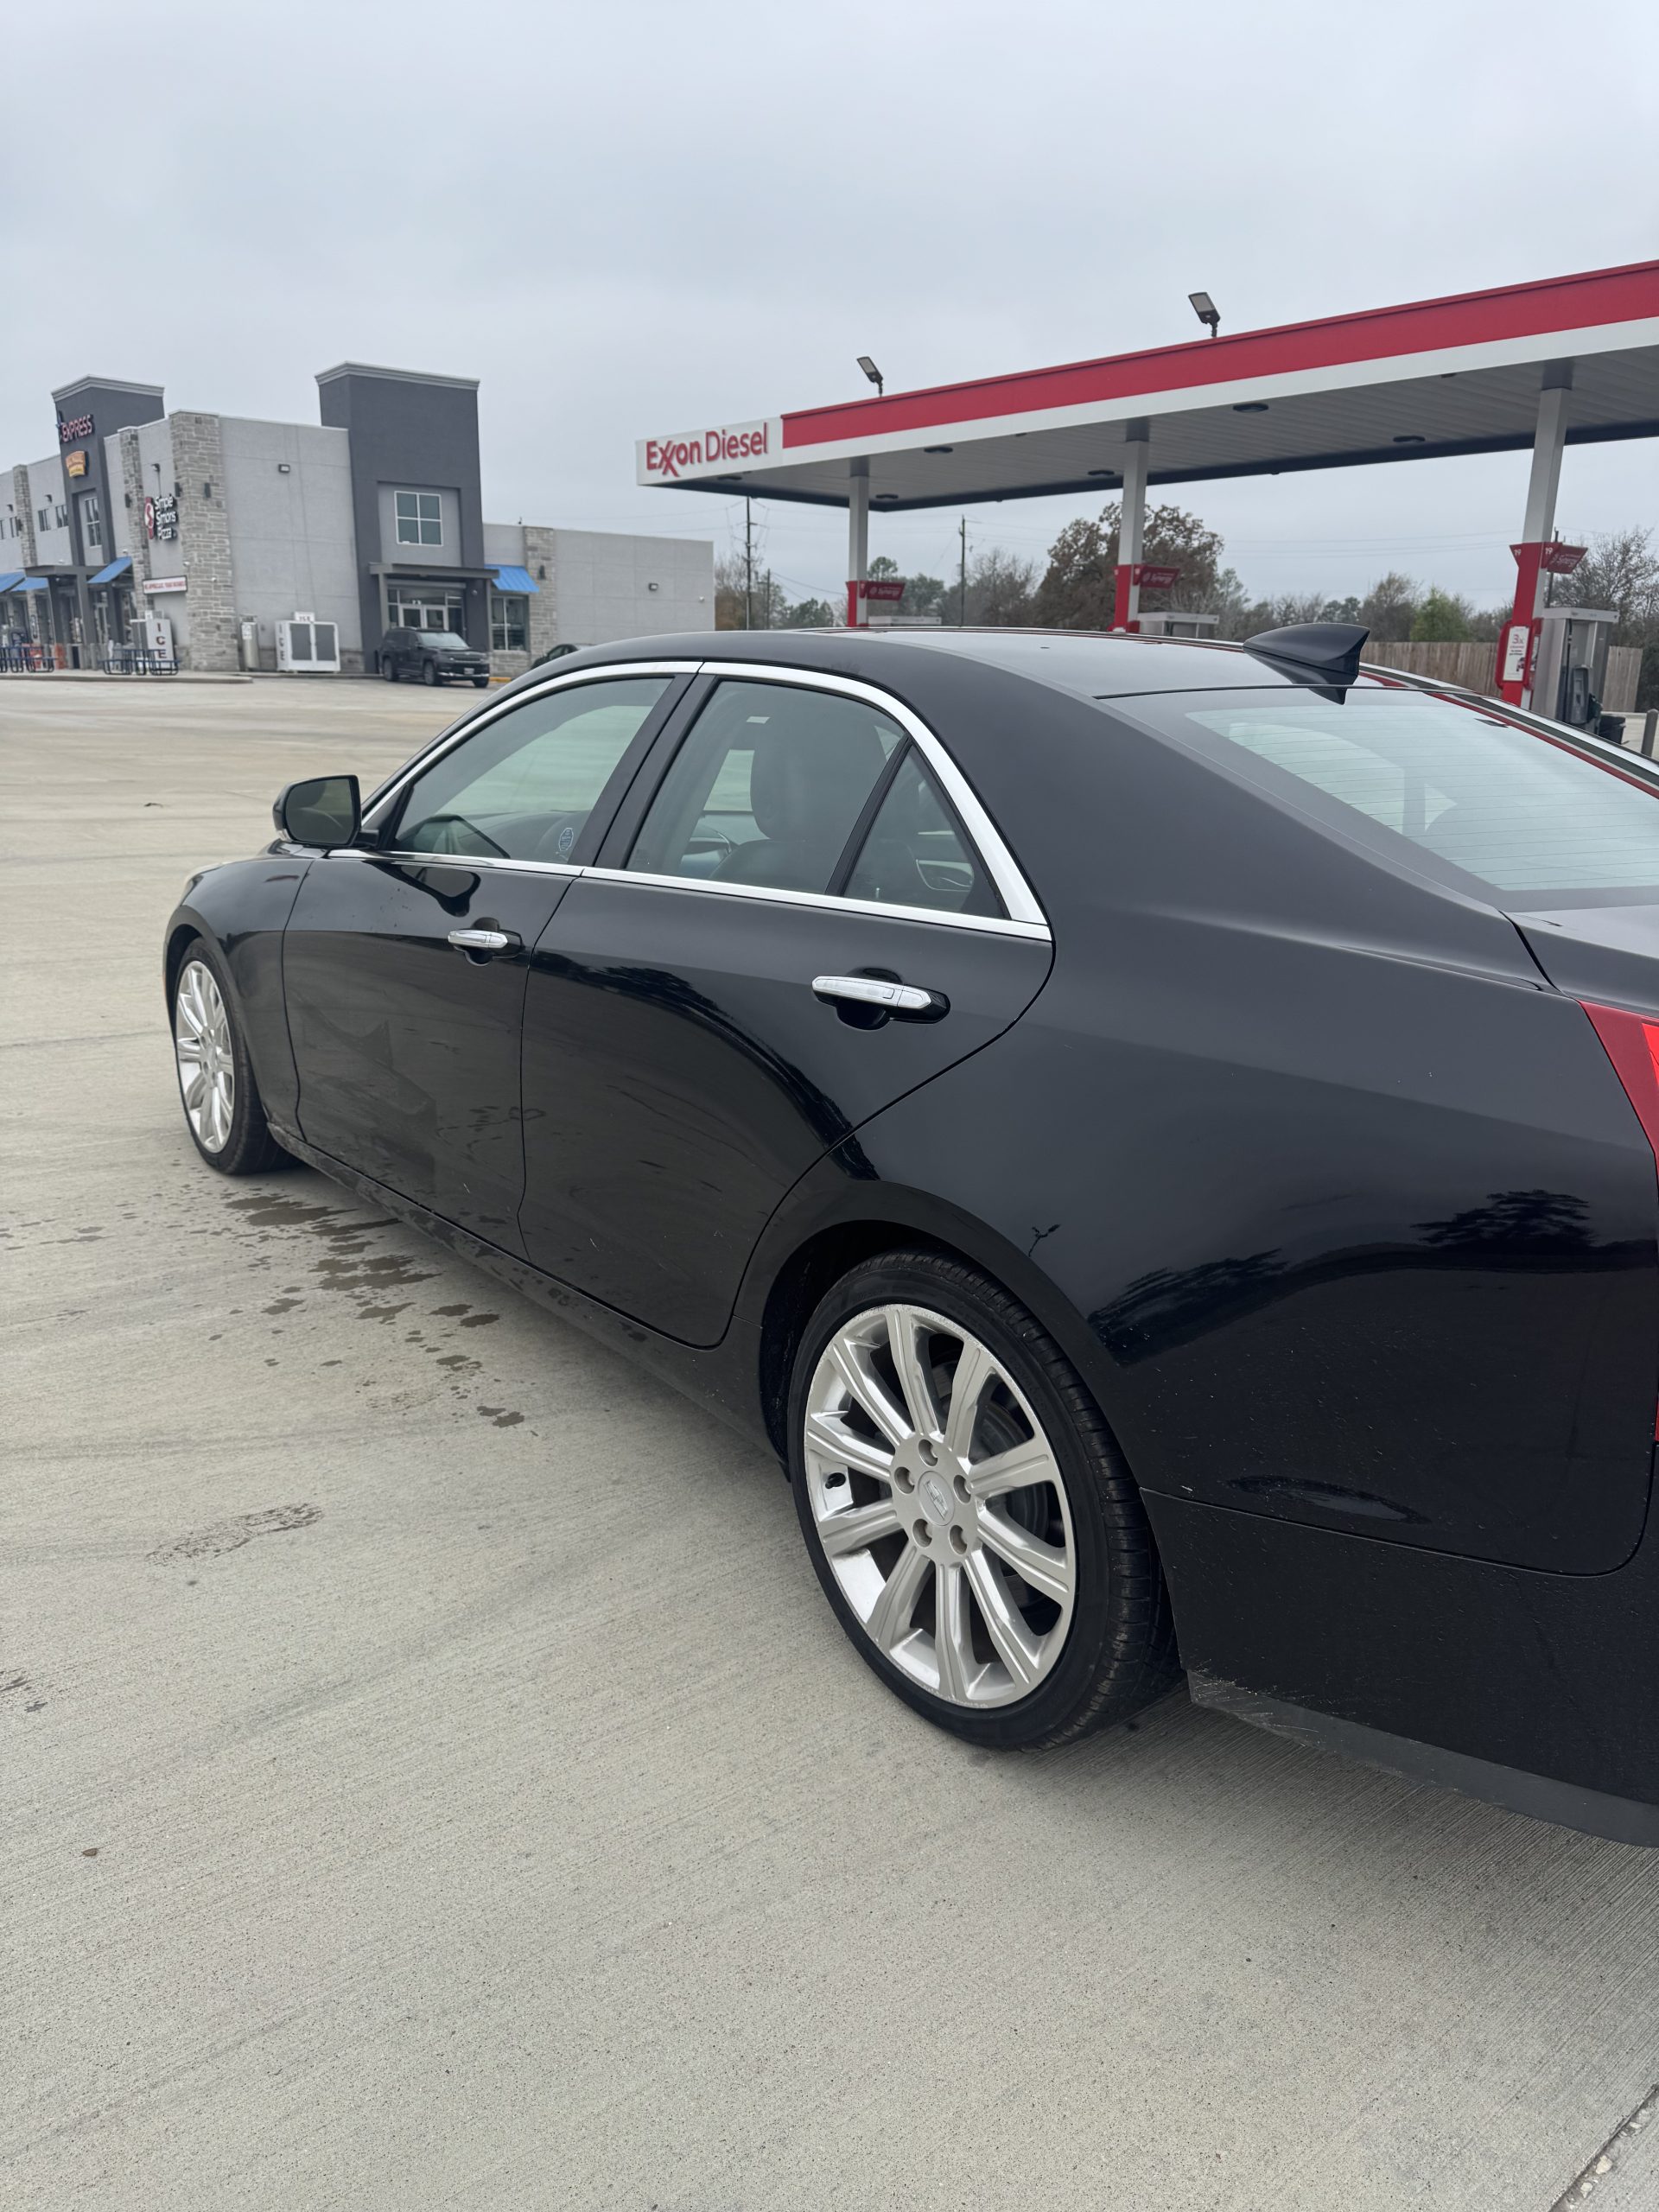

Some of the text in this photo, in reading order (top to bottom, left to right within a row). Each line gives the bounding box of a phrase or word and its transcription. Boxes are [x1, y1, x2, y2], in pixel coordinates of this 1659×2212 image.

[62, 414, 92, 442] EXPRESS
[645, 423, 768, 478] Exxon Diesel
[156, 622, 167, 659] ICE
